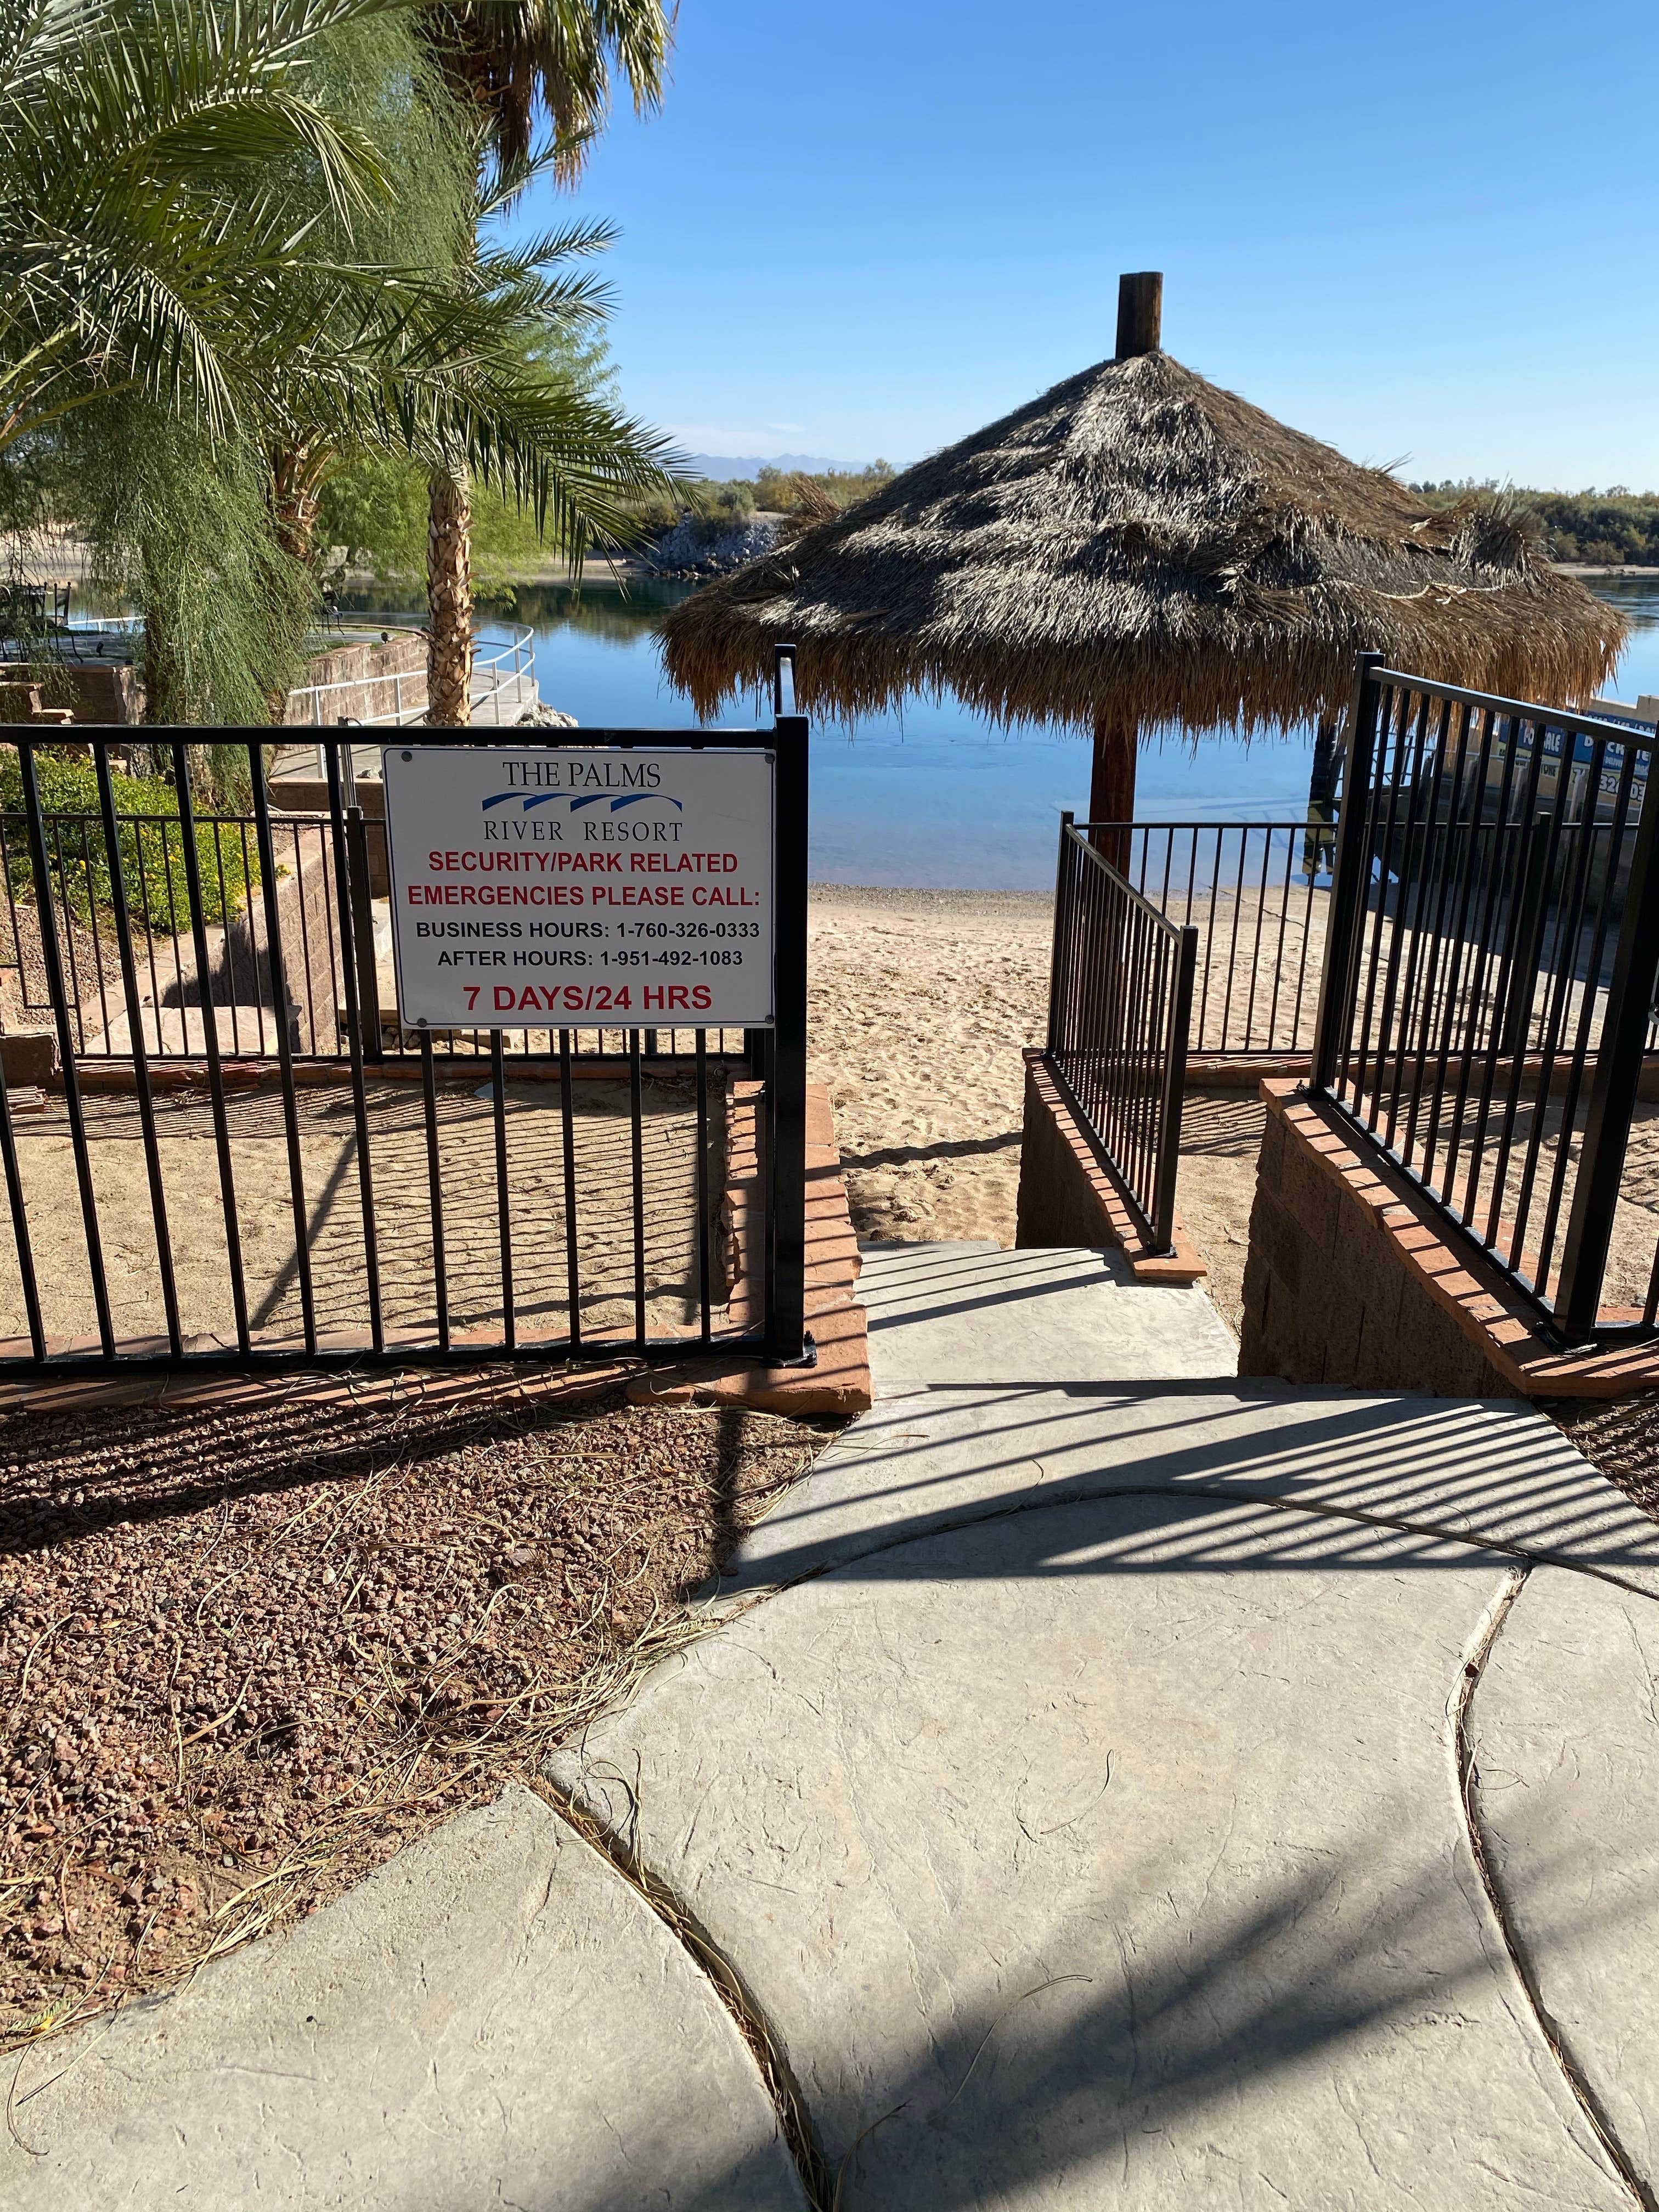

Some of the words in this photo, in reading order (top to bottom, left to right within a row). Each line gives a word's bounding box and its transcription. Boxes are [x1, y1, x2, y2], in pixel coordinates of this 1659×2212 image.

[503, 761, 561, 786] THE
[567, 762, 661, 788] PALMS
[483, 821, 563, 840] RIVER
[583, 821, 682, 842] RESORT
[428, 851, 623, 872] SECURITY/PARK
[630, 853, 738, 873] RELATED
[408, 885, 584, 906] EMERGENCIES
[592, 886, 685, 906] PLEASE
[692, 887, 760, 906] CALL:
[416, 922, 522, 938] BUSINESS
[529, 922, 610, 938] HOURS:
[617, 922, 760, 938] 1-760-326-0333
[437, 950, 507, 966] AFTER
[513, 950, 593, 966] HOURS:
[600, 950, 743, 966] 1-951-492-1083
[462, 986, 481, 1011] 7
[493, 985, 632, 1011] DAYS/24
[643, 985, 712, 1009] HRS
